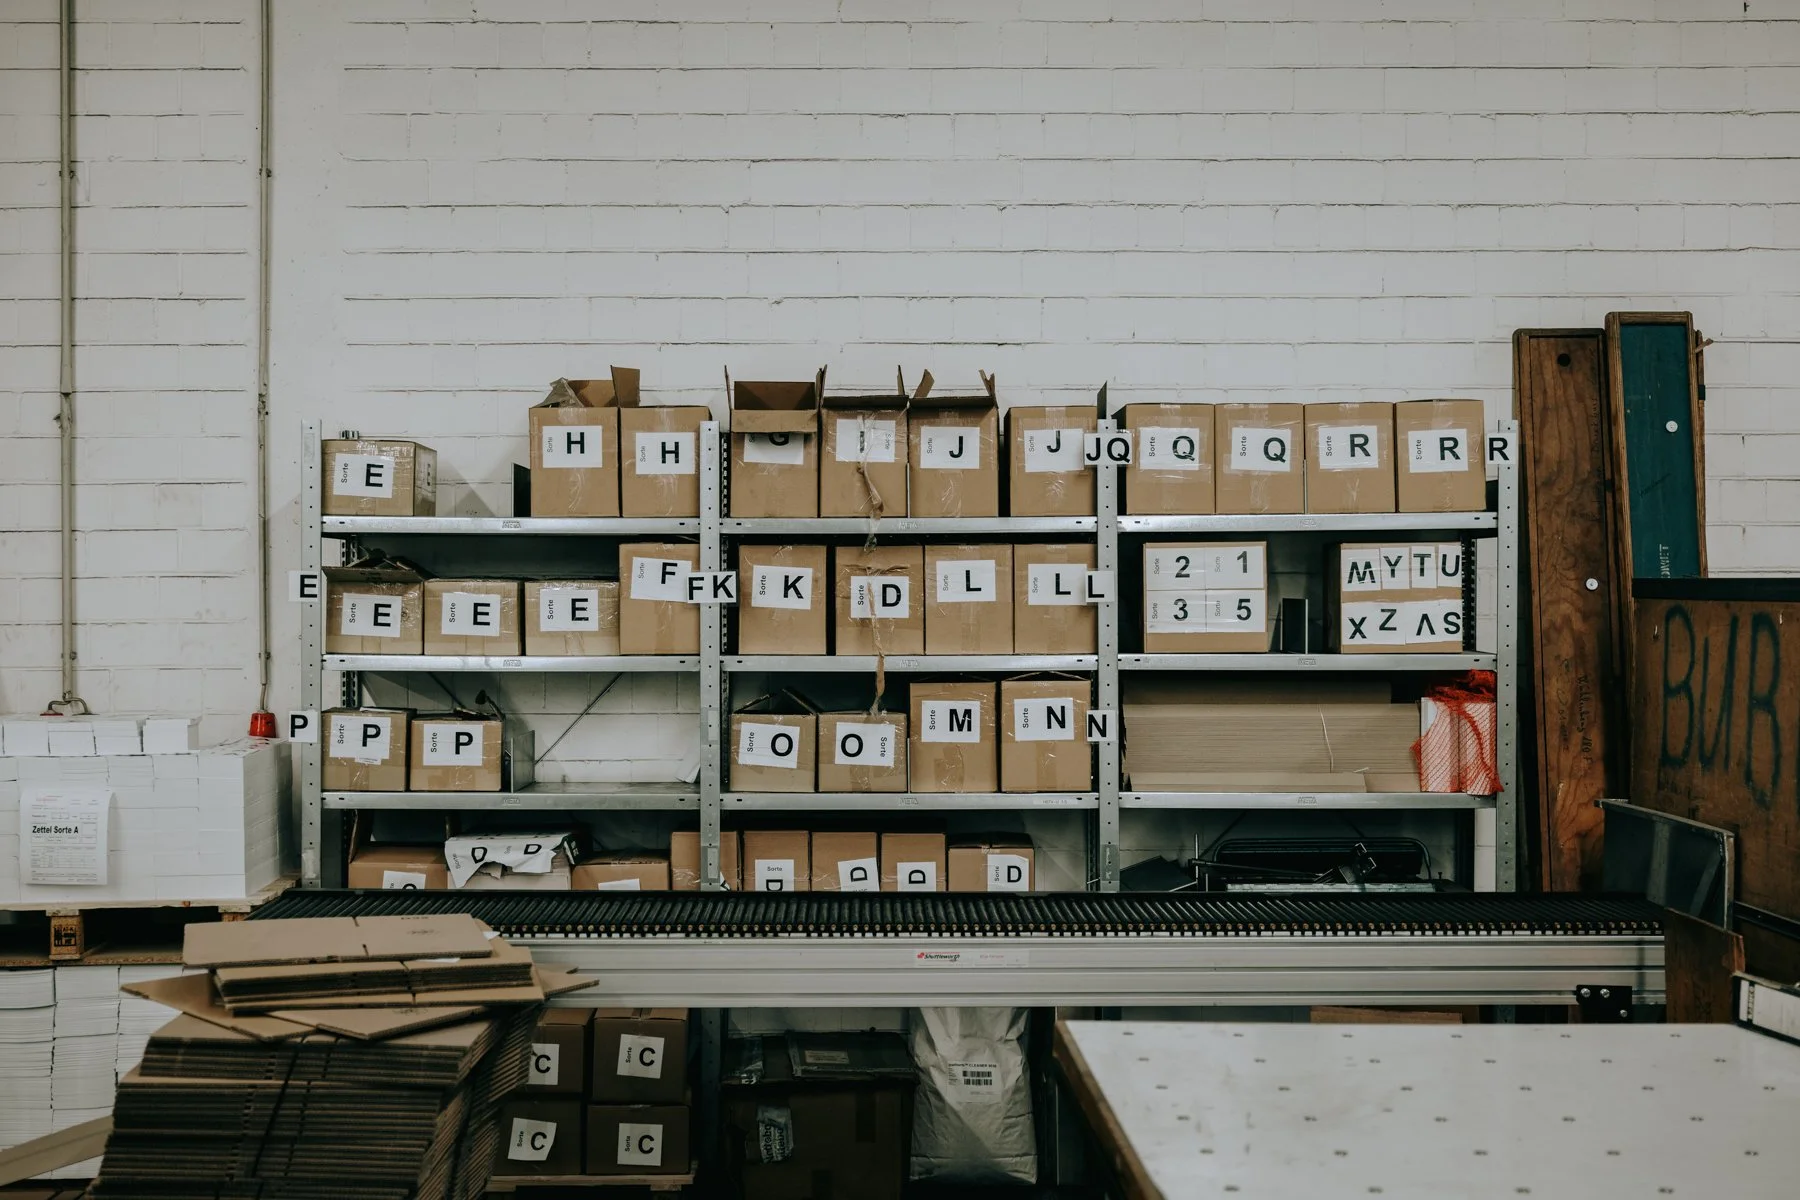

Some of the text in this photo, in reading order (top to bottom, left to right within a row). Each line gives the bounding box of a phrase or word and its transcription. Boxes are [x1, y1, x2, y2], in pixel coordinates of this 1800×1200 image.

[566, 432, 585, 454] H
[661, 441, 680, 464] H
[949, 436, 964, 459] J
[1046, 430, 1061, 453] J
[1172, 435, 1195, 462] Q
[1263, 437, 1286, 463] Q
[1349, 433, 1371, 458] R
[1439, 436, 1461, 461] R
[1488, 437, 1510, 461] R
[341, 463, 384, 488] Sorte E
[1175, 555, 1191, 578] 2
[1236, 550, 1248, 573] 1
[1383, 555, 1403, 578] Y
[1413, 553, 1432, 577] T
[1441, 553, 1460, 577] U
[661, 562, 678, 585] F
[965, 569, 982, 592] L
[1055, 573, 1071, 595] L
[300, 574, 317, 598] E
[759, 574, 805, 599] Sorte K
[857, 583, 902, 607] Sorte D
[1087, 575, 1105, 598] L
[373, 603, 392, 627] E
[473, 602, 491, 626] E
[571, 598, 589, 622] E
[1173, 598, 1189, 621] 3
[1236, 598, 1252, 620] 5
[1348, 616, 1367, 640] X
[1378, 608, 1397, 631] Z
[1443, 611, 1461, 635] S
[290, 714, 308, 738] P
[949, 708, 972, 732] M
[1046, 705, 1066, 730] N
[1087, 714, 1107, 738] N
[337, 723, 381, 747] Sorte P
[430, 731, 474, 755] Sorte P
[746, 731, 794, 757] Sorte O
[840, 733, 888, 758] O Sorte
[32, 826, 79, 834] Zettel Sorte A
[471, 847, 488, 864] D
[524, 843, 542, 855] D
[850, 866, 868, 882] D
[908, 869, 926, 884] D
[1007, 865, 1022, 883] D
[534, 1054, 551, 1074] C
[639, 1047, 656, 1067] C
[531, 1131, 548, 1151] C
[638, 1135, 655, 1155] C
